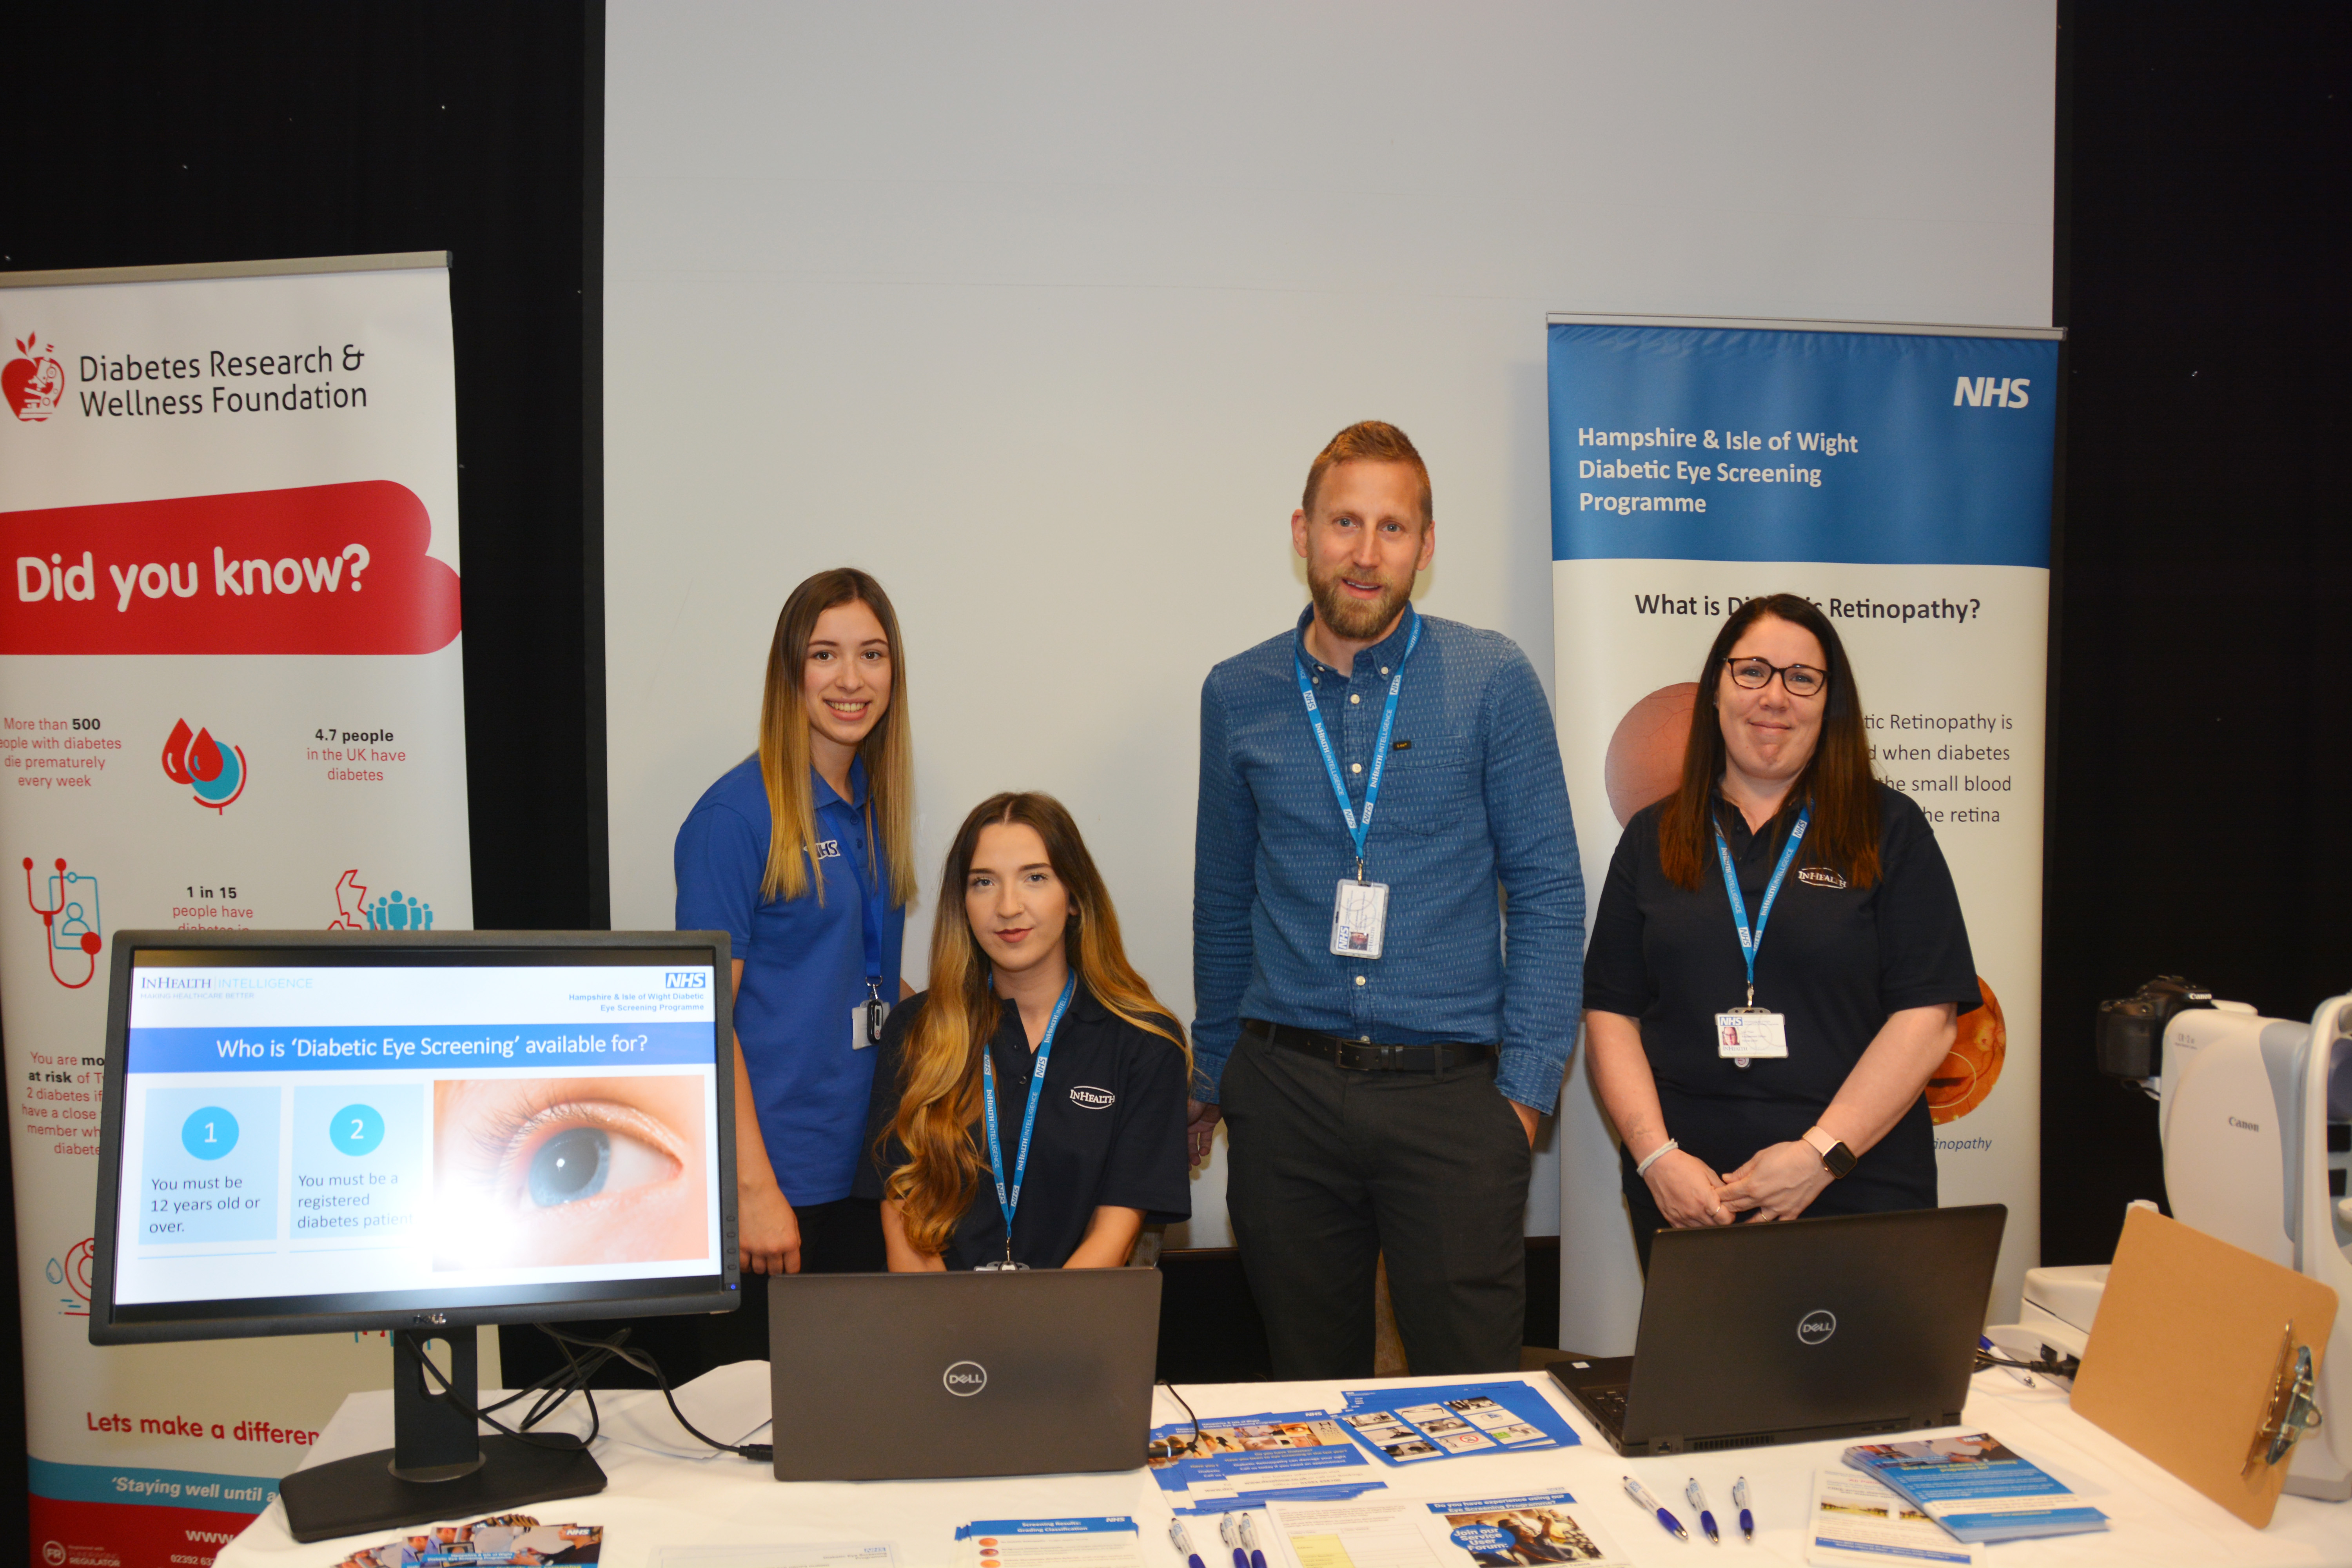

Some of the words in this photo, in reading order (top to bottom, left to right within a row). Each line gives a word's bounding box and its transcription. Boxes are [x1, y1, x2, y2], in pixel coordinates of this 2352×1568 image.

[80, 354, 200, 381] Diabetes
[210, 346, 332, 377] Research
[342, 344, 365, 371] &
[80, 389, 202, 417] Wellness
[212, 383, 368, 413] Foundation
[1954, 377, 2031, 408] NHS
[1578, 426, 1697, 450] Hampshire
[1703, 430, 1720, 449] &
[1726, 431, 1761, 450] Isle
[1768, 432, 1791, 451] of
[1797, 432, 1858, 456] Wight
[1579, 460, 1670, 480] Diabetic
[1676, 462, 1711, 485] Eye
[1717, 463, 1822, 488] Screening
[1580, 492, 1706, 515] Programme
[16, 551, 95, 602] Did
[109, 561, 198, 612] you
[214, 543, 370, 596] know?
[1635, 594, 1697, 615] What
[1704, 595, 1720, 616] is
[1829, 598, 1981, 623] Retinopathy?
[1390, 675, 1401, 695] NHS
[1304, 691, 1316, 710] NHS
[4, 717, 34, 730] More
[39, 718, 67, 730] than
[72, 718, 100, 730] 500
[1891, 713, 1996, 733] Retinopathy
[2002, 714, 2013, 730] is
[315, 729, 337, 741] 4.7
[342, 729, 394, 744] people
[1379, 709, 1393, 754] INTELLIGENCE
[32, 737, 59, 749] with
[64, 737, 122, 750] diabetes
[307, 748, 318, 760] in
[322, 748, 342, 761] the
[347, 749, 367, 761] UK
[371, 748, 406, 762] have
[1882, 744, 1931, 760] when
[1938, 744, 2010, 760] diabetes
[4, 755, 21, 768] die
[25, 756, 105, 771] prematurely
[18, 776, 52, 789] every
[56, 775, 91, 787] week
[327, 768, 383, 781] diabetes
[1327, 754, 1345, 796] INTELLIGENCE
[1912, 775, 1958, 791] small
[1965, 775, 2011, 791] blood
[1345, 810, 1356, 828] NHS
[1363, 803, 1373, 824] NHS
[1951, 807, 2000, 822] retina
[1794, 821, 1806, 837] NHS
[1773, 848, 1794, 885] INTELLIGENCE
[187, 886, 193, 898] 1
[200, 886, 213, 898] in
[220, 887, 237, 898] 15
[1727, 873, 1742, 914] INTELLIGENCE
[173, 905, 217, 919] people
[222, 905, 253, 918] have
[1338, 926, 1349, 950] NHS
[1740, 928, 1751, 947] NHS
[218, 978, 313, 989] INTELLIGENCE
[666, 973, 705, 987] NHS
[648, 993, 670, 1001] Wight
[601, 1004, 614, 1013] Eye
[617, 1004, 657, 1012] Screening
[659, 1004, 704, 1012] Programme
[1720, 1017, 1742, 1026] NHS
[216, 1039, 264, 1058] Who
[270, 1040, 285, 1057] is
[383, 1038, 415, 1060] Eye
[526, 1035, 606, 1054] available
[611, 1034, 648, 1052] for?
[31, 1051, 53, 1064] You
[57, 1056, 77, 1065] are
[82, 1057, 105, 1066] mo
[1036, 1058, 1046, 1077] NHS
[29, 1072, 40, 1081] at
[45, 1071, 72, 1083] risk
[77, 1072, 90, 1083] of
[27, 1087, 33, 1098] 2
[36, 1088, 90, 1102] diabetes
[22, 1103, 47, 1118] have
[52, 1109, 58, 1118] a
[63, 1107, 96, 1120] close
[1025, 1092, 1038, 1136] INTELLIGENCE
[27, 1124, 77, 1136] member
[350, 1120, 364, 1140] 2
[2229, 1116, 2259, 1132] Canon
[204, 1122, 217, 1143] 1
[989, 1123, 1000, 1168] INTELLIGENCE
[152, 1179, 177, 1191] You
[183, 1178, 220, 1190] must
[225, 1176, 243, 1189] be
[298, 1174, 324, 1187] You
[328, 1174, 365, 1186] must
[368, 1172, 386, 1185] be
[390, 1175, 398, 1185] a
[151, 1200, 168, 1212] 12
[174, 1200, 212, 1214] years
[217, 1197, 240, 1211] old
[245, 1198, 261, 1209] or
[298, 1194, 370, 1210] registered
[149, 1221, 185, 1233] over.
[298, 1216, 359, 1229] diabetes
[414, 1314, 446, 1324] DELL
[1803, 1323, 1832, 1333] DELL
[949, 1374, 982, 1384] DELL
[87, 1412, 131, 1433] Lets
[140, 1416, 203, 1437] make
[211, 1424, 224, 1439] a
[233, 1421, 319, 1446] differen
[186, 1484, 219, 1498] well
[224, 1487, 262, 1502] until
[1506, 1501, 1556, 1509] Programme?
[1460, 1533, 1503, 1541] Service
[47, 1548, 62, 1559] FR
[69, 1557, 120, 1567] REGULATOR
